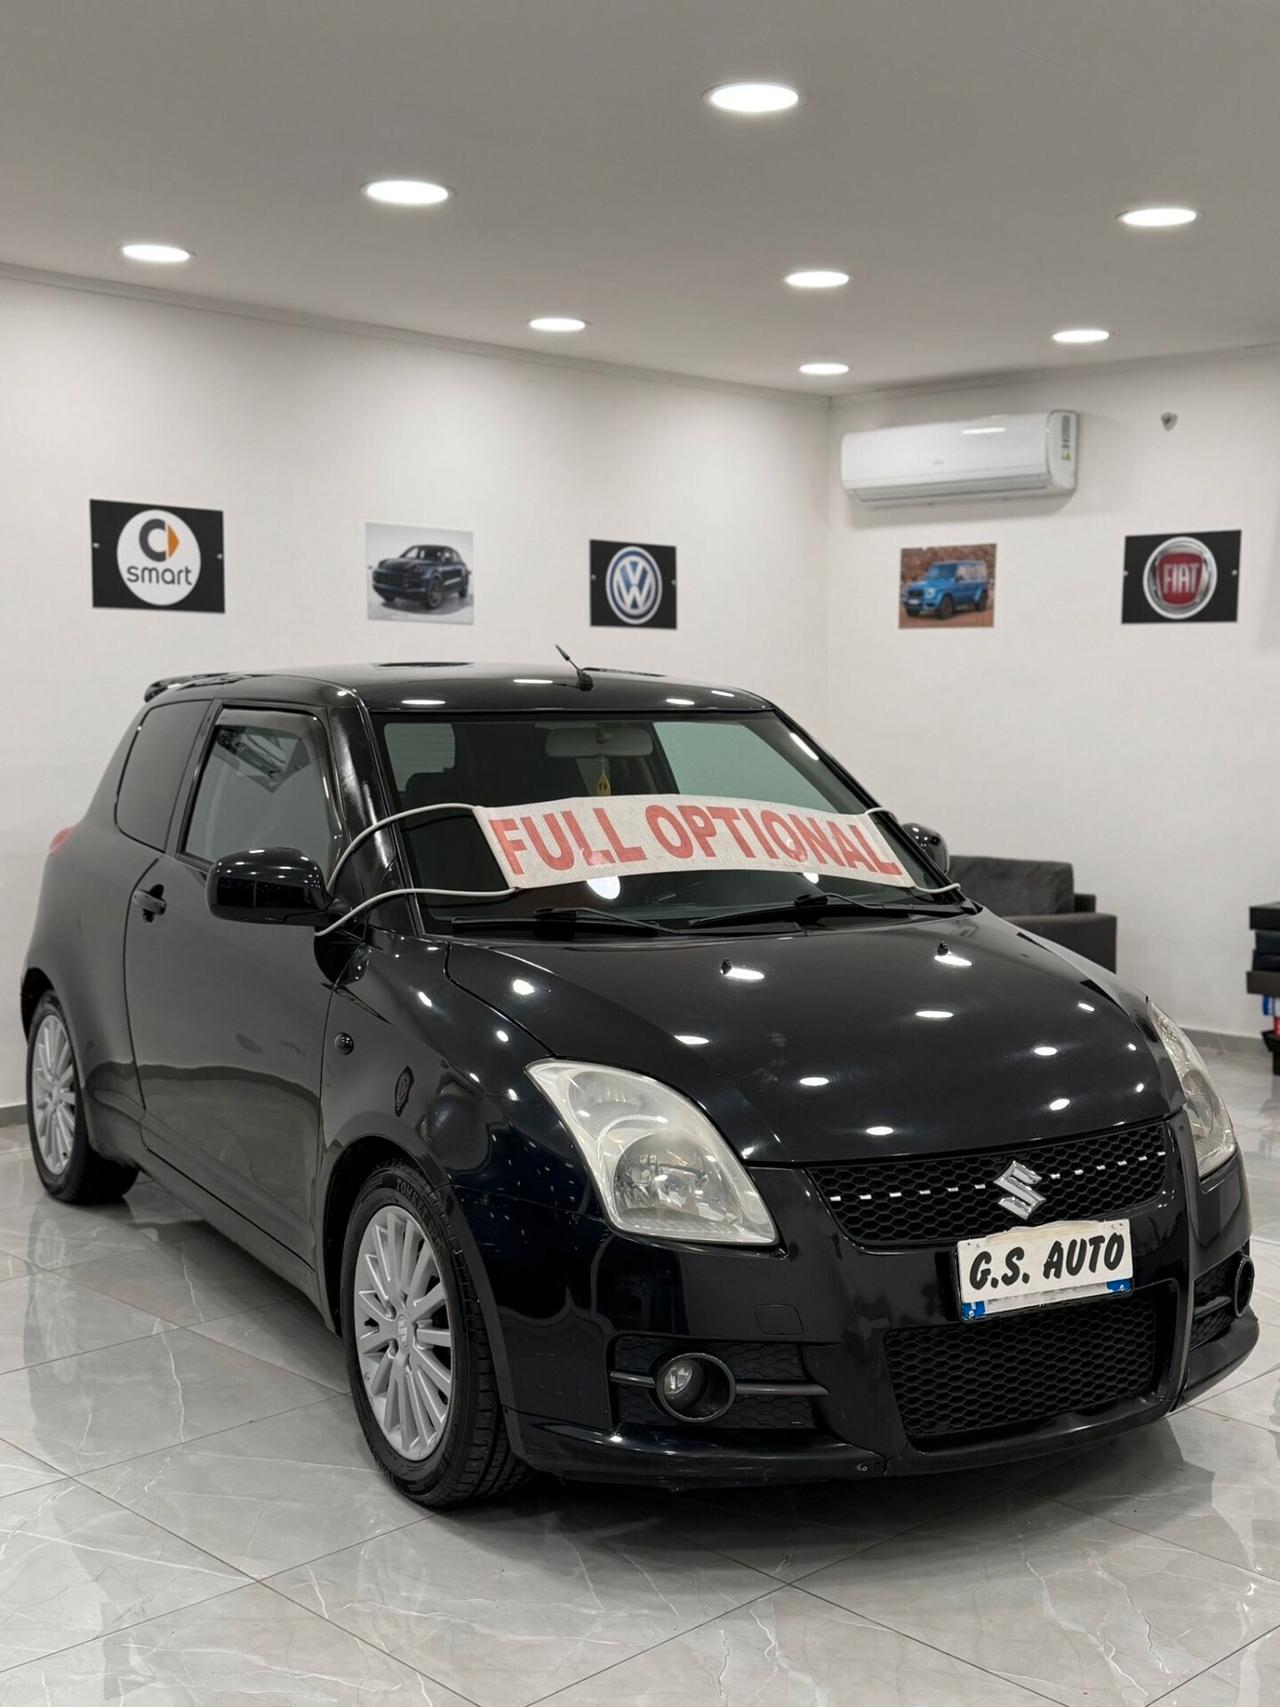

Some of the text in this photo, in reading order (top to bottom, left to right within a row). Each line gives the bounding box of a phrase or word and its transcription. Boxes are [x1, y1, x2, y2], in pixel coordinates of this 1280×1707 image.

[126, 565, 192, 586] smart
[1163, 563, 1201, 594] FIAT
[488, 804, 903, 877] FULL OPTIONAL
[969, 1232, 1125, 1290] G.S. AUTO
